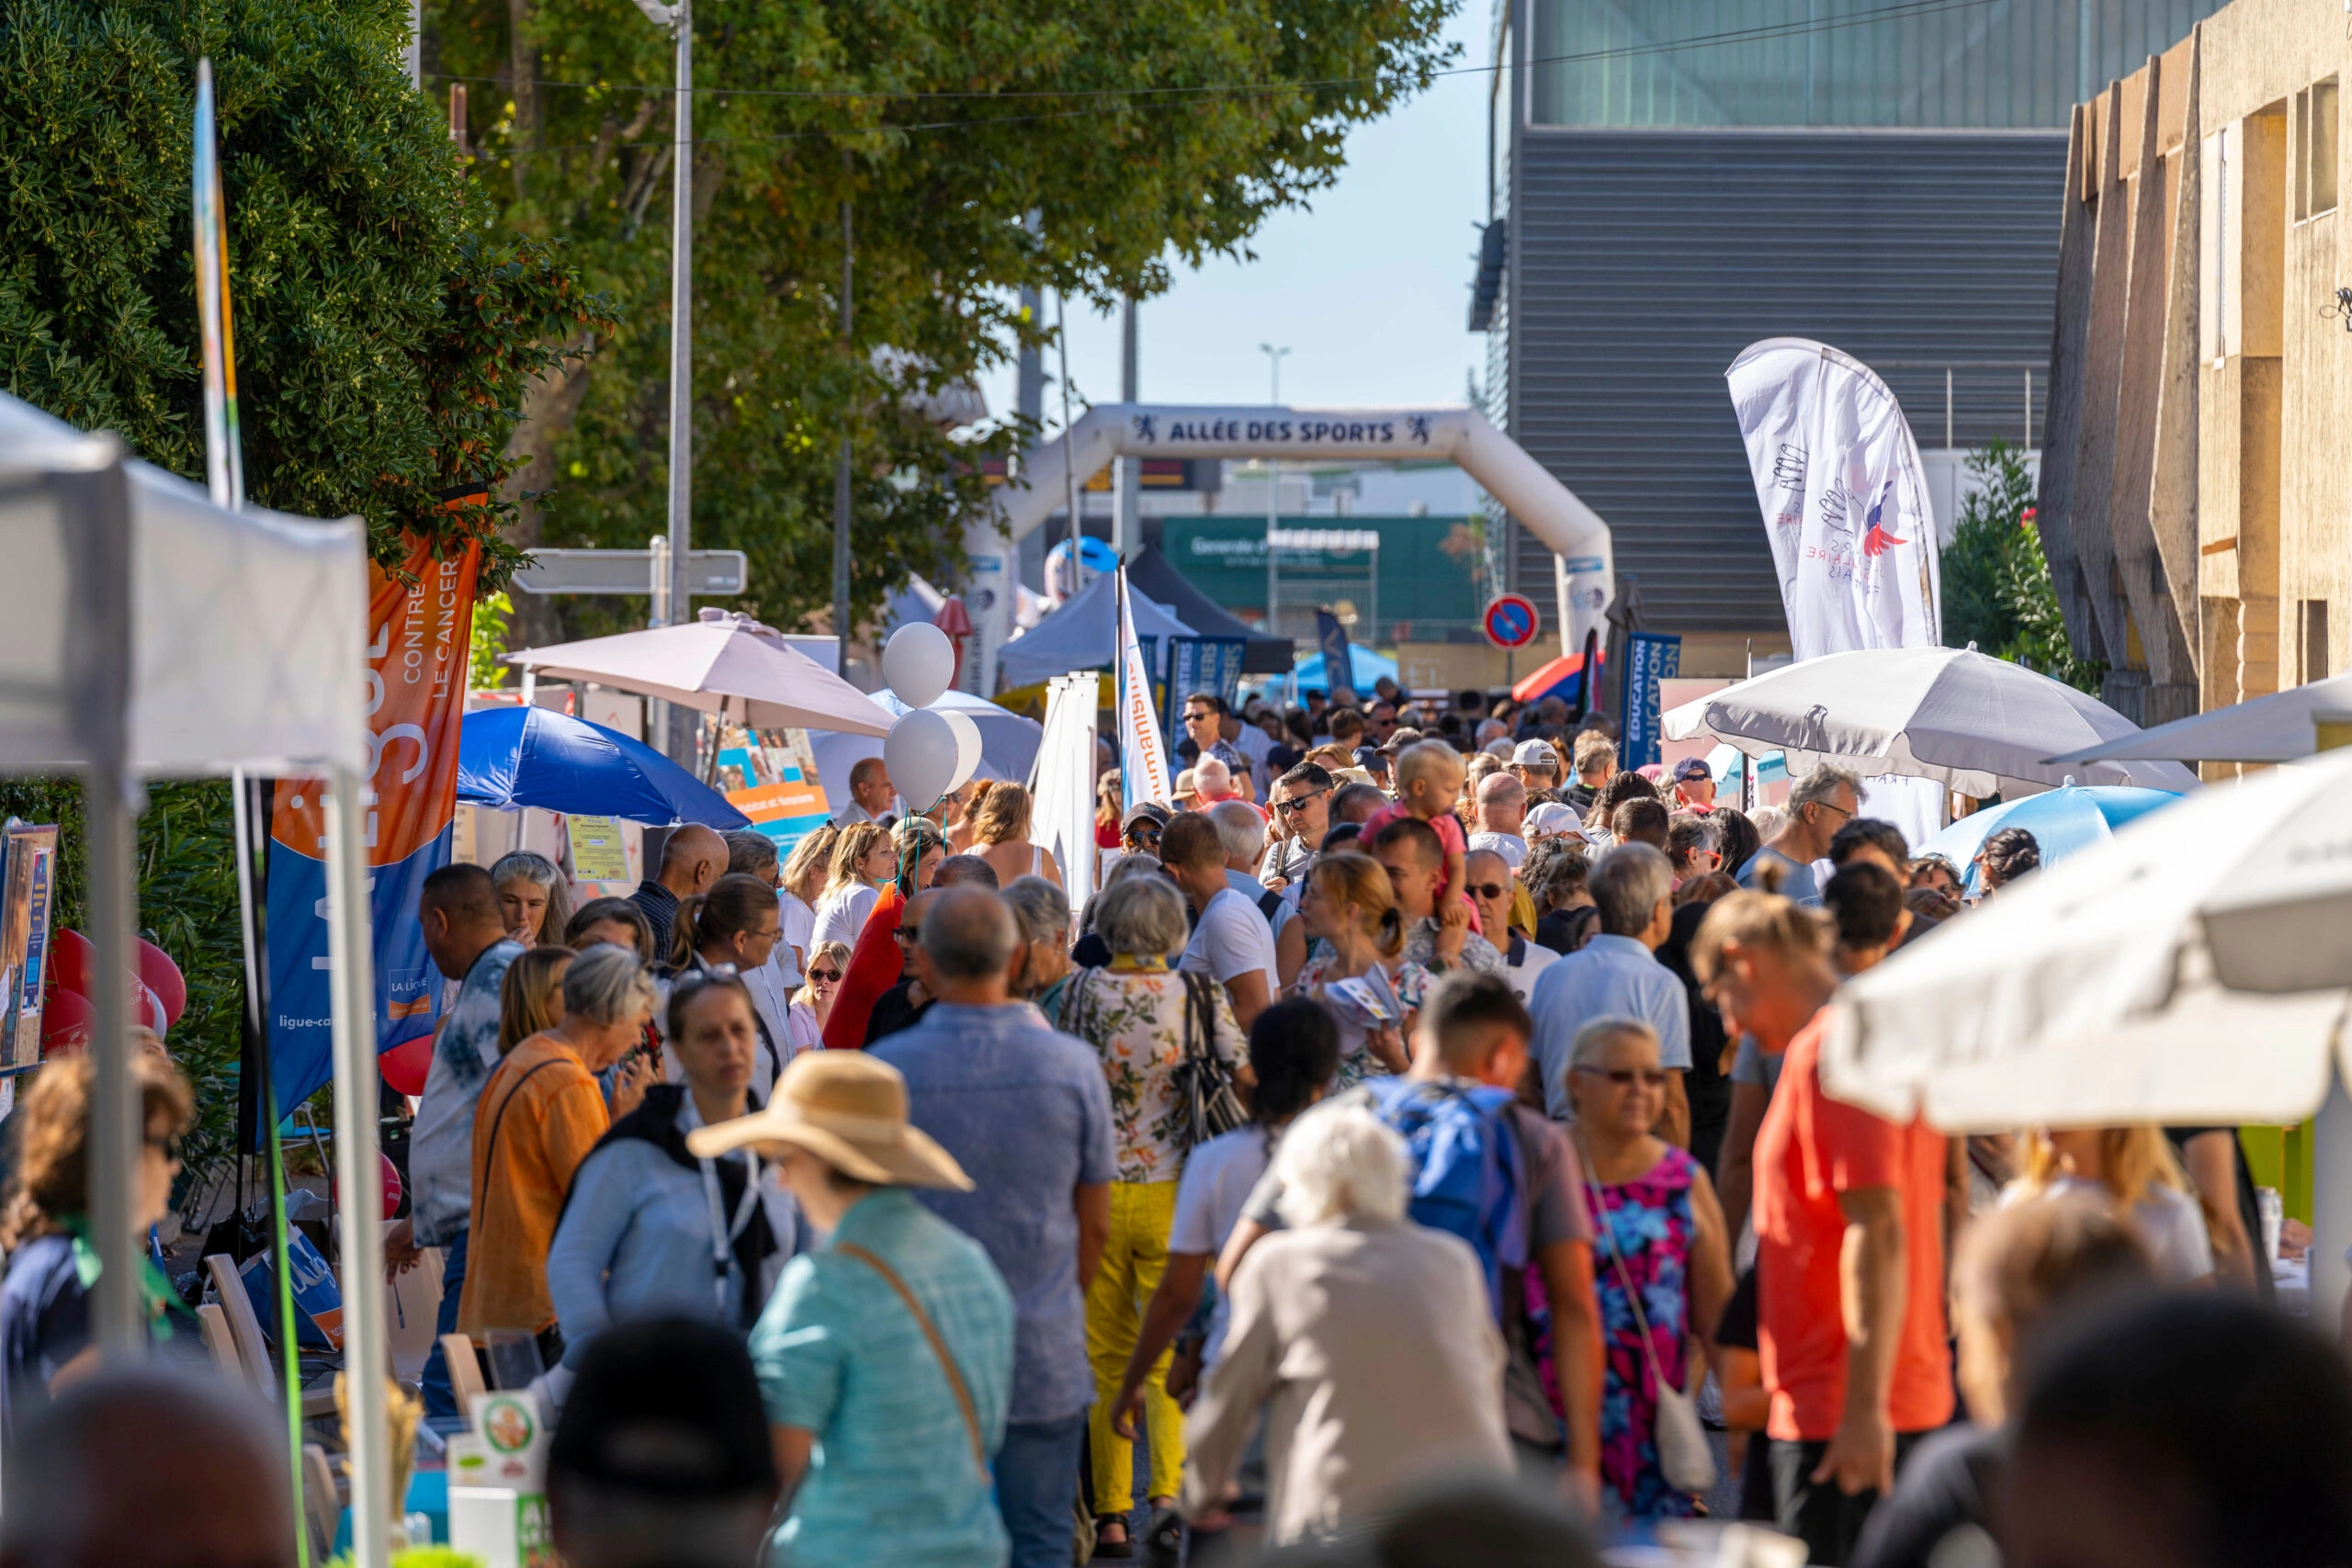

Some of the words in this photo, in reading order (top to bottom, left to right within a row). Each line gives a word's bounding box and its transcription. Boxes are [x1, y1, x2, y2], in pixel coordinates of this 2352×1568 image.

[1170, 417, 1238, 442] ALLÉE
[1247, 421, 1292, 442] DES
[1299, 421, 1394, 443] SPORTS
[435, 560, 458, 662] CANCER
[403, 583, 425, 684] CONTRE
[433, 669, 448, 698] LE
[391, 982, 403, 992] LA
